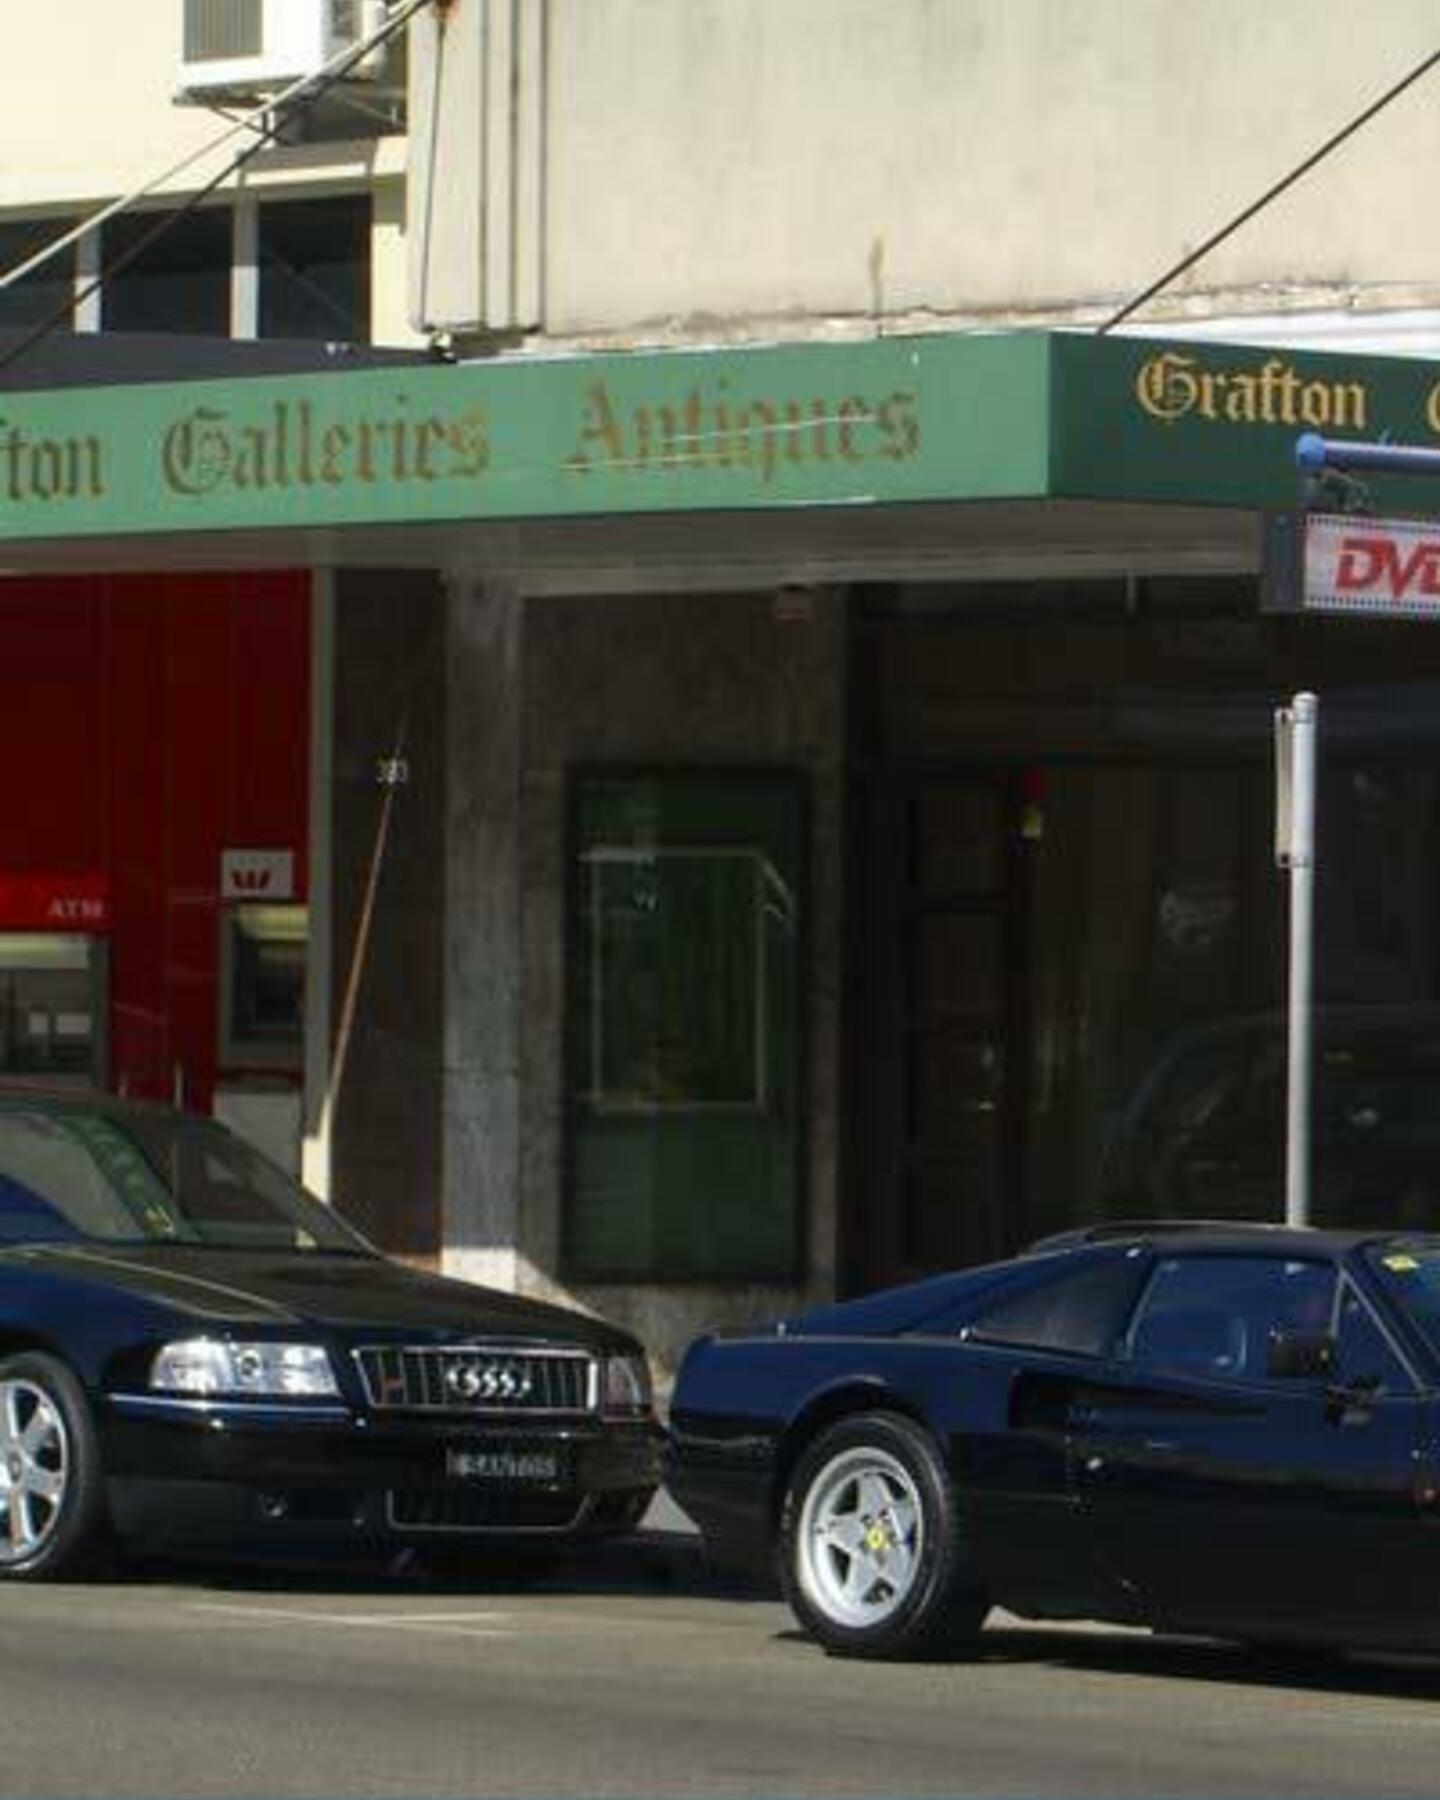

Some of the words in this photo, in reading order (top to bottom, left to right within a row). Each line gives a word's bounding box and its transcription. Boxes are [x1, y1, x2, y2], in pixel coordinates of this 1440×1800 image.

[162, 395, 490, 496] Galleries
[560, 376, 920, 484] Antiques
[1136, 352, 1366, 430] Grafton
